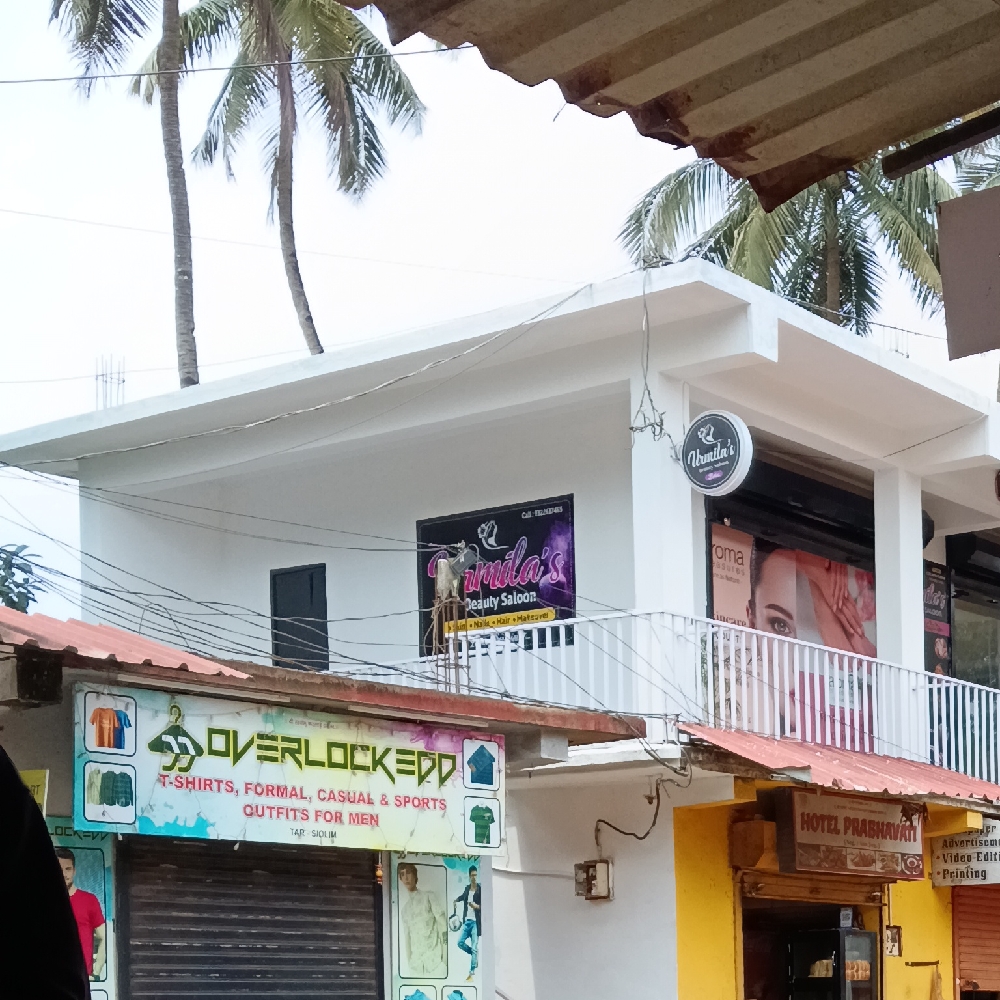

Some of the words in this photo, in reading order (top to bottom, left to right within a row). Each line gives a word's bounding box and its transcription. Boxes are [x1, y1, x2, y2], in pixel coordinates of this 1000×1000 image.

[158, 773, 239, 797] T-SHIRTS,
[243, 782, 312, 804] FORMAL,
[317, 788, 375, 806] CASUAL
[380, 794, 389, 806] &
[394, 795, 448, 811] SPORTS
[242, 803, 310, 822] OUTFITS
[314, 809, 343, 825] FOR
[348, 813, 380, 827] MEN
[800, 811, 841, 836] HOTEL
[843, 815, 918, 843] PRABHAVATI
[942, 852, 972, 864] Video
[942, 867, 988, 881] Printing
